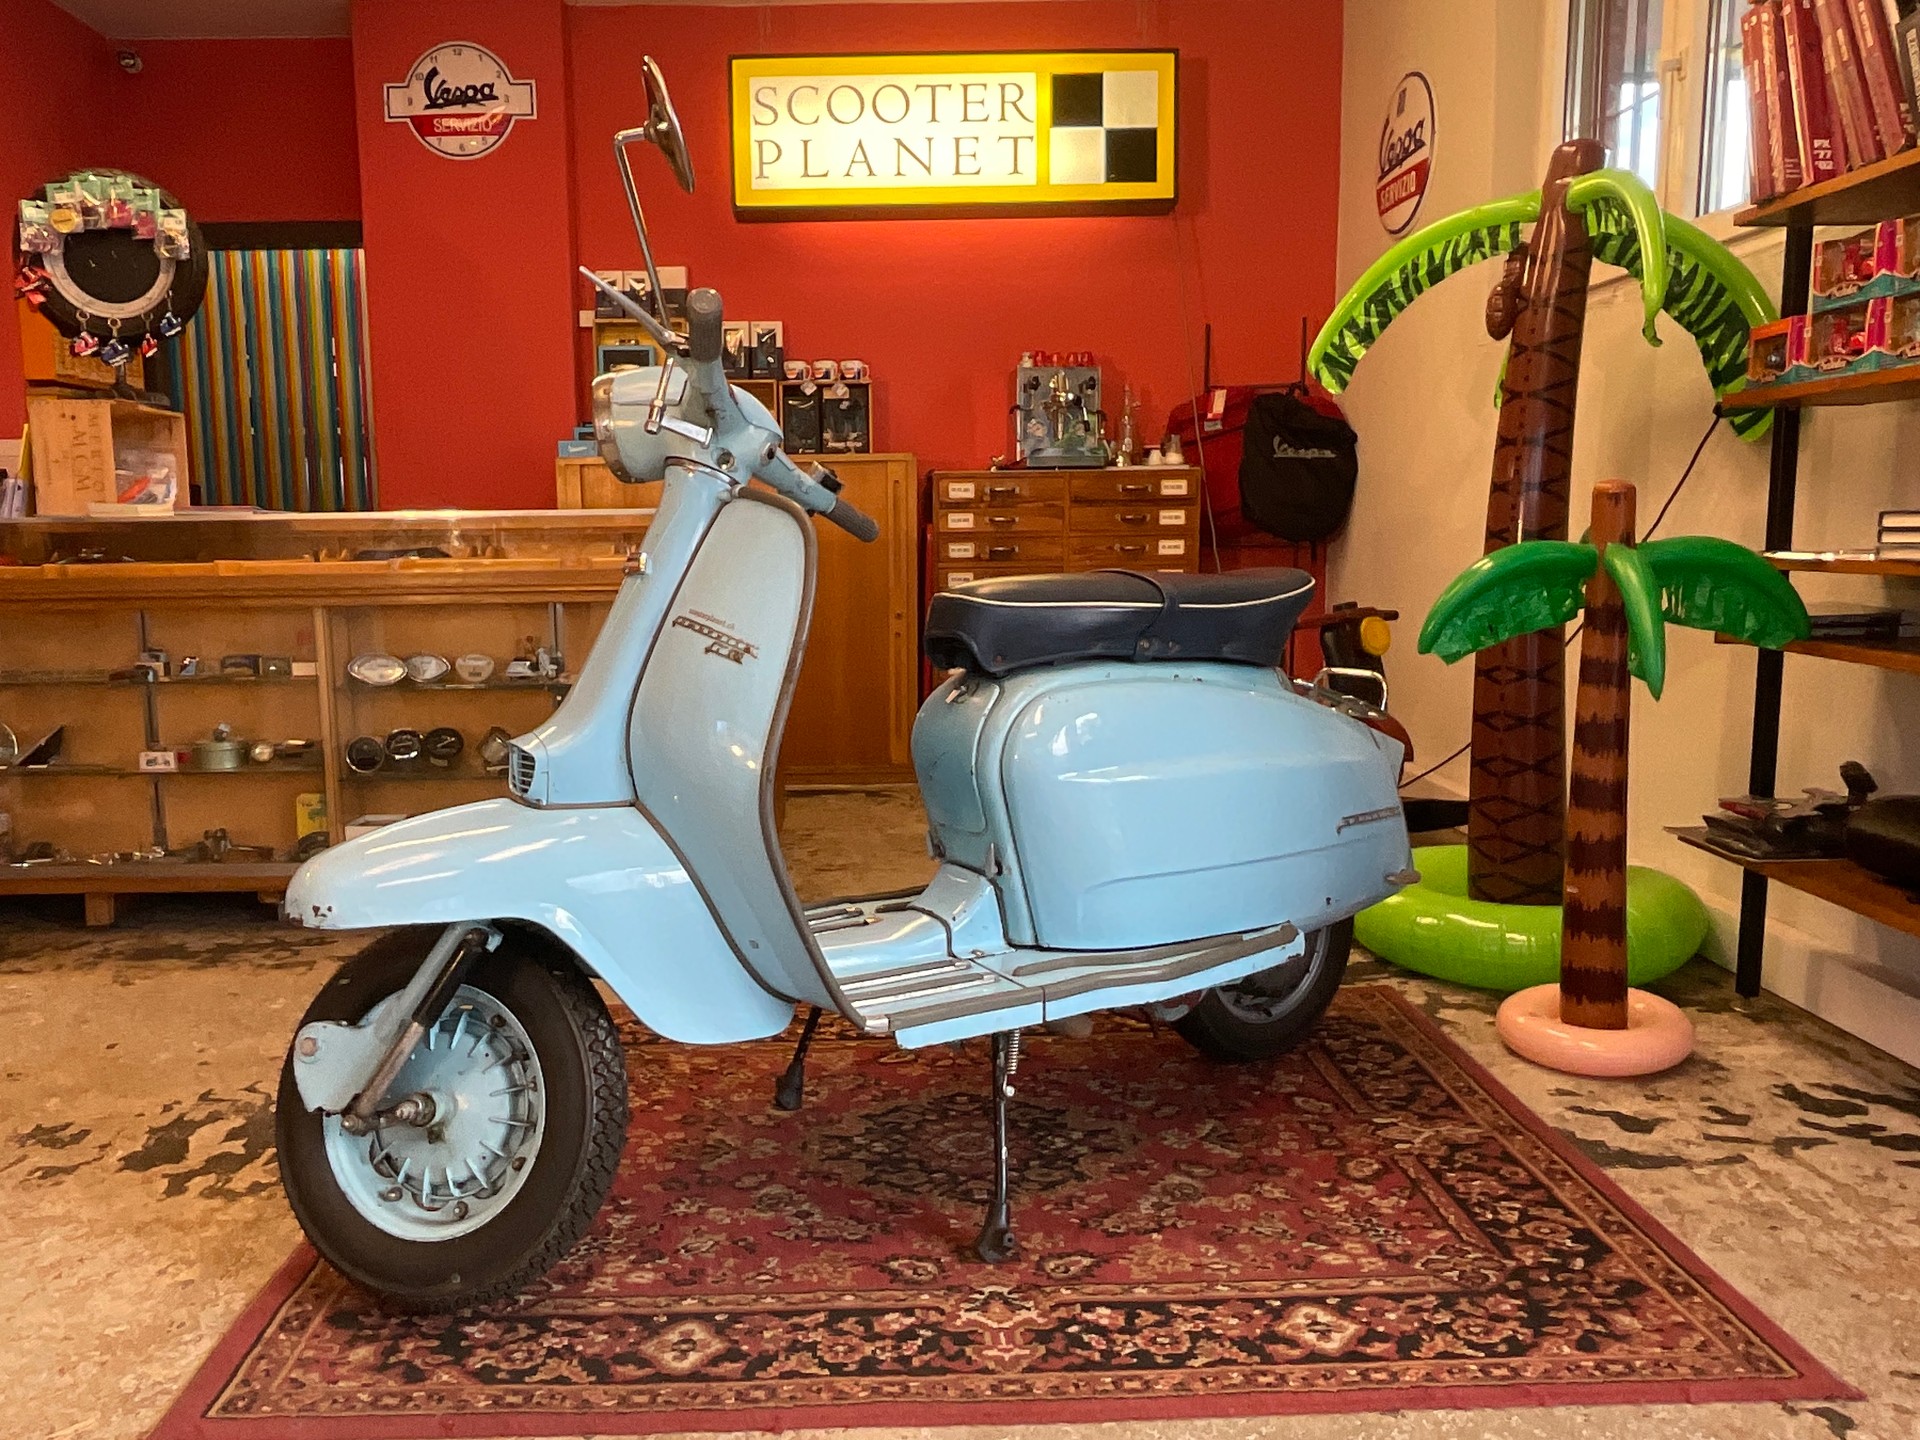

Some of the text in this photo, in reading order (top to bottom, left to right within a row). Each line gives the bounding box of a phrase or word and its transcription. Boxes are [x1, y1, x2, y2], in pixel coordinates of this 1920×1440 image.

[423, 66, 499, 110] Vespa
[753, 82, 1034, 126] SCOOTER
[433, 117, 493, 133] SERVIZIO
[753, 135, 1034, 179] PLANET
[1378, 117, 1426, 184] Vespa
